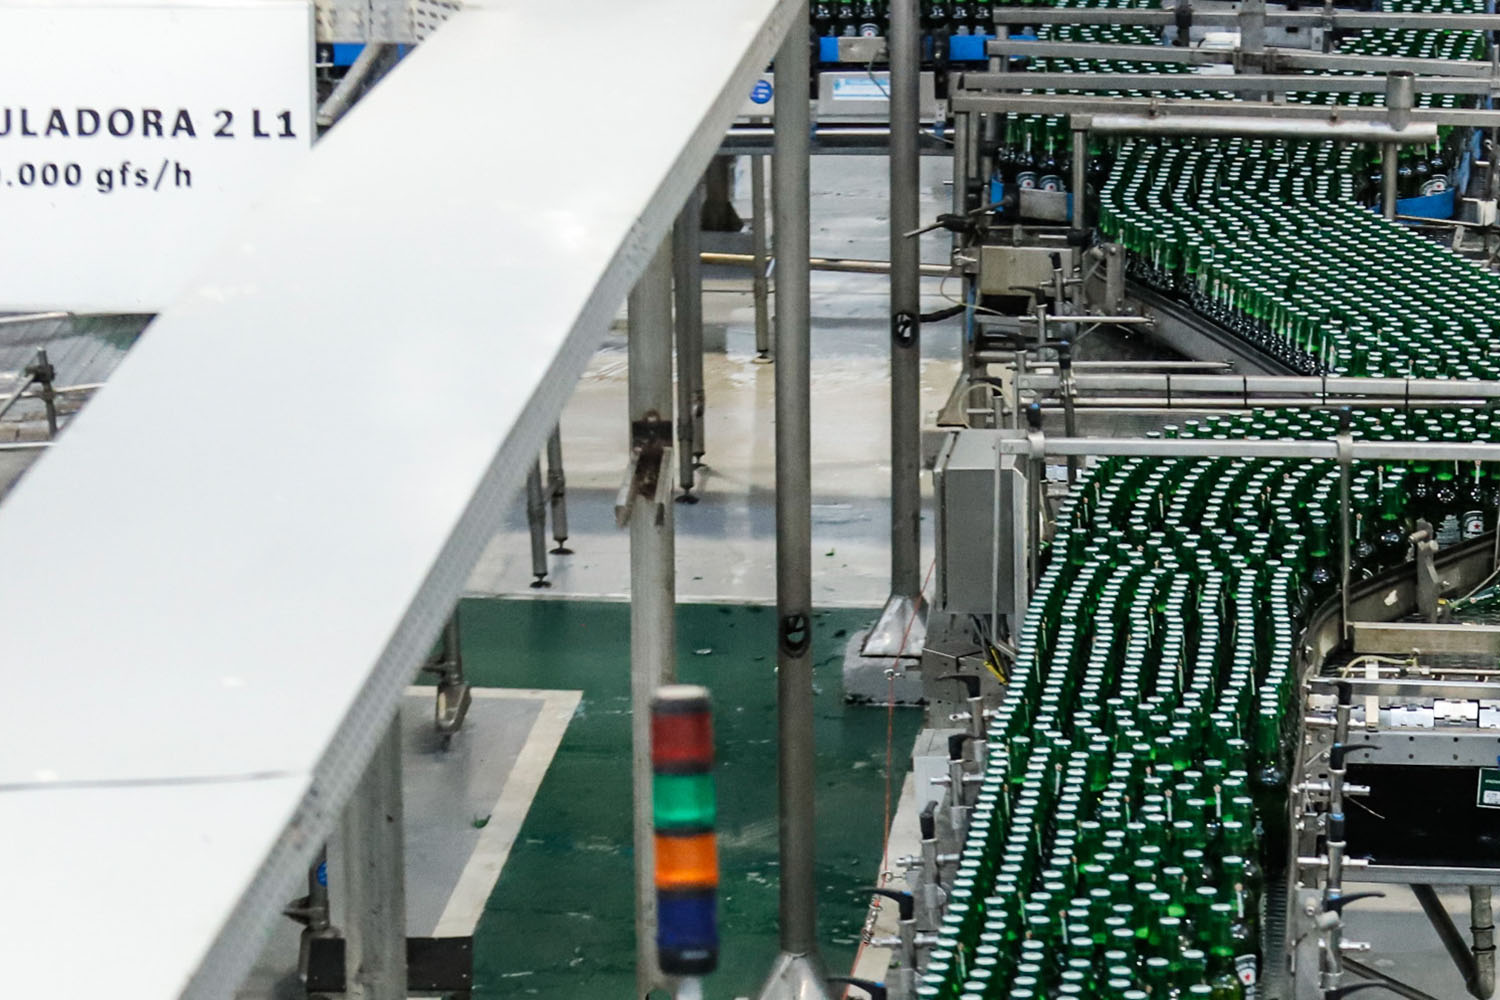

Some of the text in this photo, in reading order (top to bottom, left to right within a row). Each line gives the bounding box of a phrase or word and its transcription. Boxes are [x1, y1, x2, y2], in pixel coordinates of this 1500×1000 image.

[213, 110, 235, 138] 2
[252, 109, 297, 138] L1
[0, 158, 192, 193] .000 gfs/h
